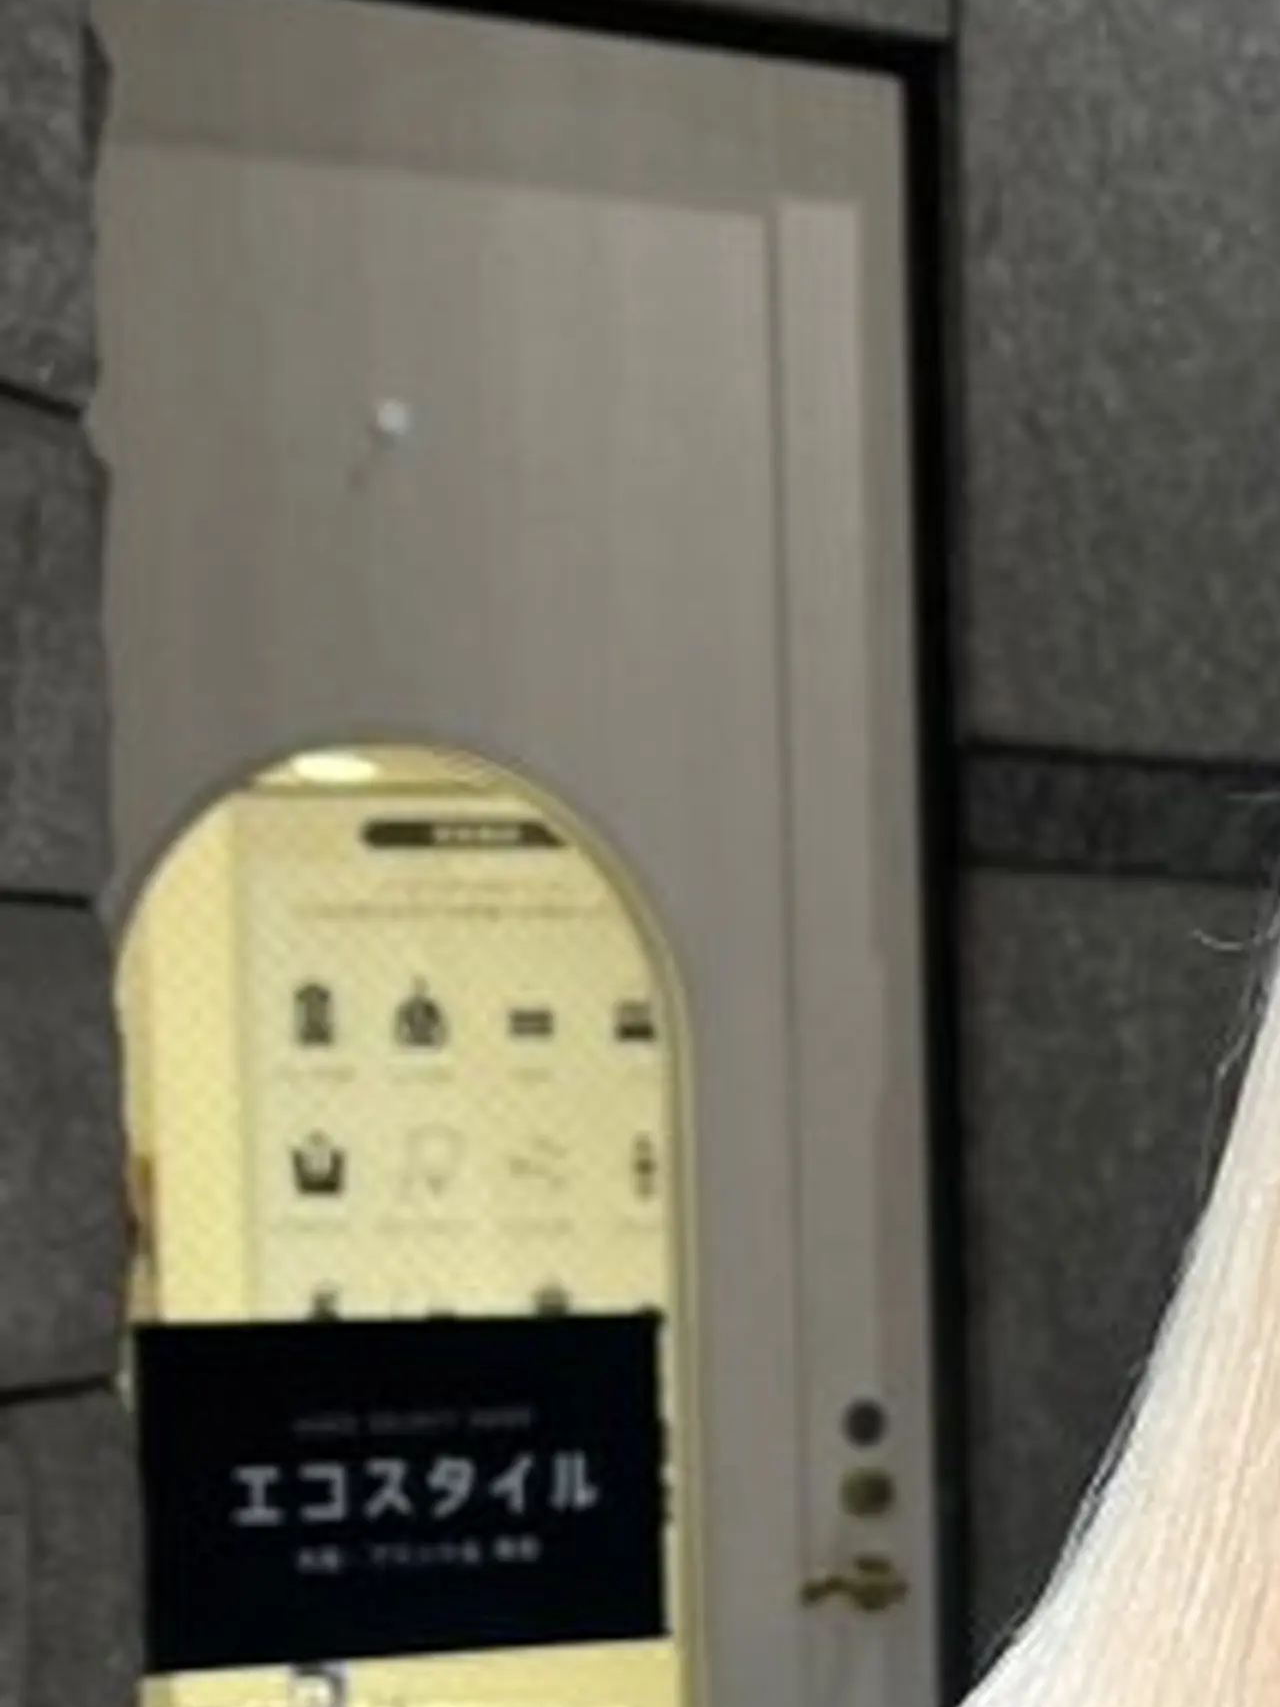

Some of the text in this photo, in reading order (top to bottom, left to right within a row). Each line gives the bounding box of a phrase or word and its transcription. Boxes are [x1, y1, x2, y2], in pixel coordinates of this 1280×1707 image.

[231, 1450, 599, 1528] エコスタイル
